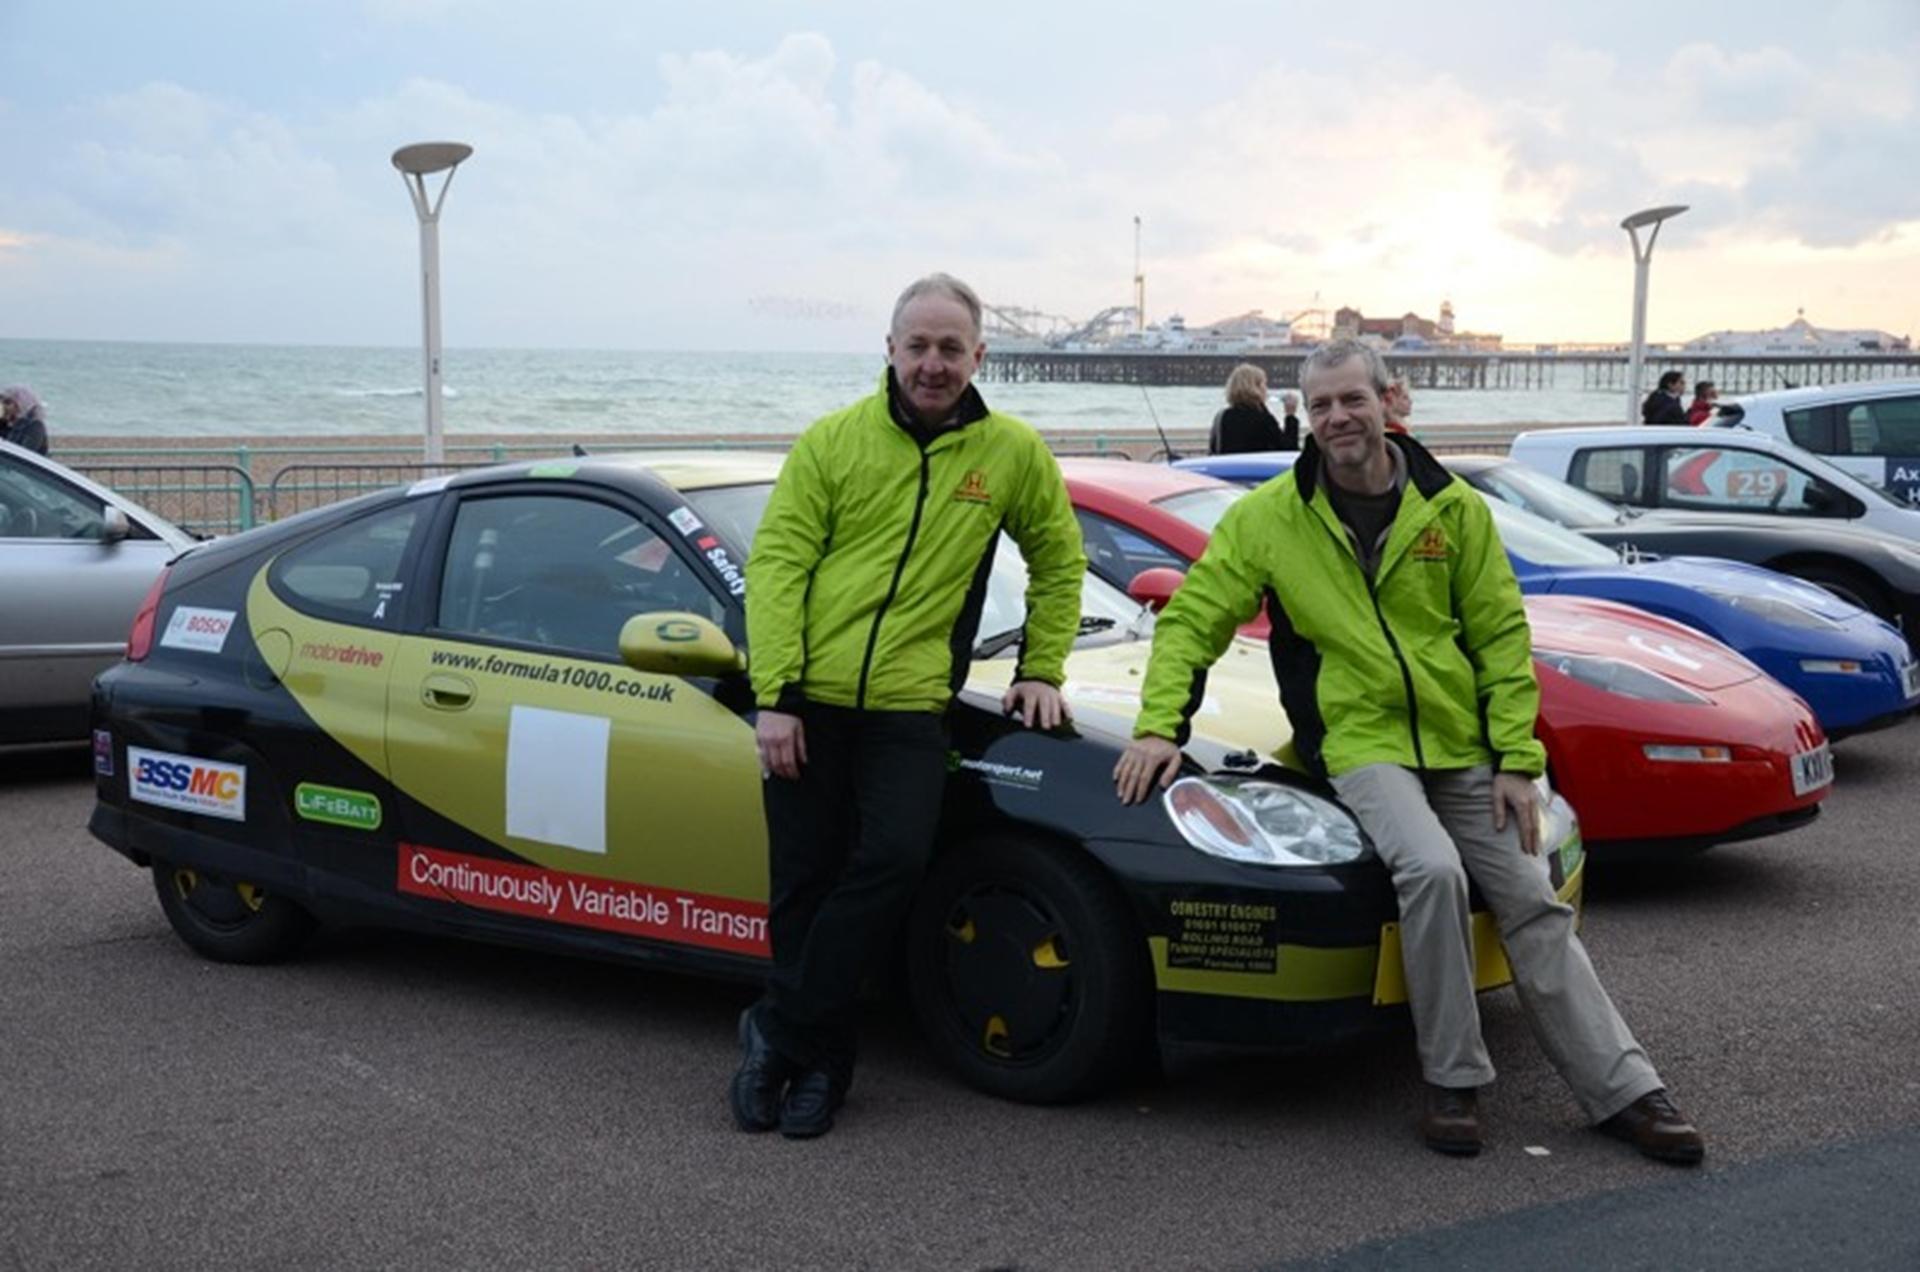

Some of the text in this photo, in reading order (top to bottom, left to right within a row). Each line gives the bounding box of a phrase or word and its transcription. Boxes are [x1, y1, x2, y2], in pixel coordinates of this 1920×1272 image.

[1738, 472, 1777, 496] 29
[707, 547, 746, 596] Safety
[186, 615, 230, 635] BOSCH
[302, 641, 384, 669] motordrive
[431, 650, 675, 703] www.formula1000.co.uk
[135, 757, 241, 801] BSSMC
[410, 854, 768, 942] Continuously Variable Transm
[1230, 903, 1276, 920] ENGINES
